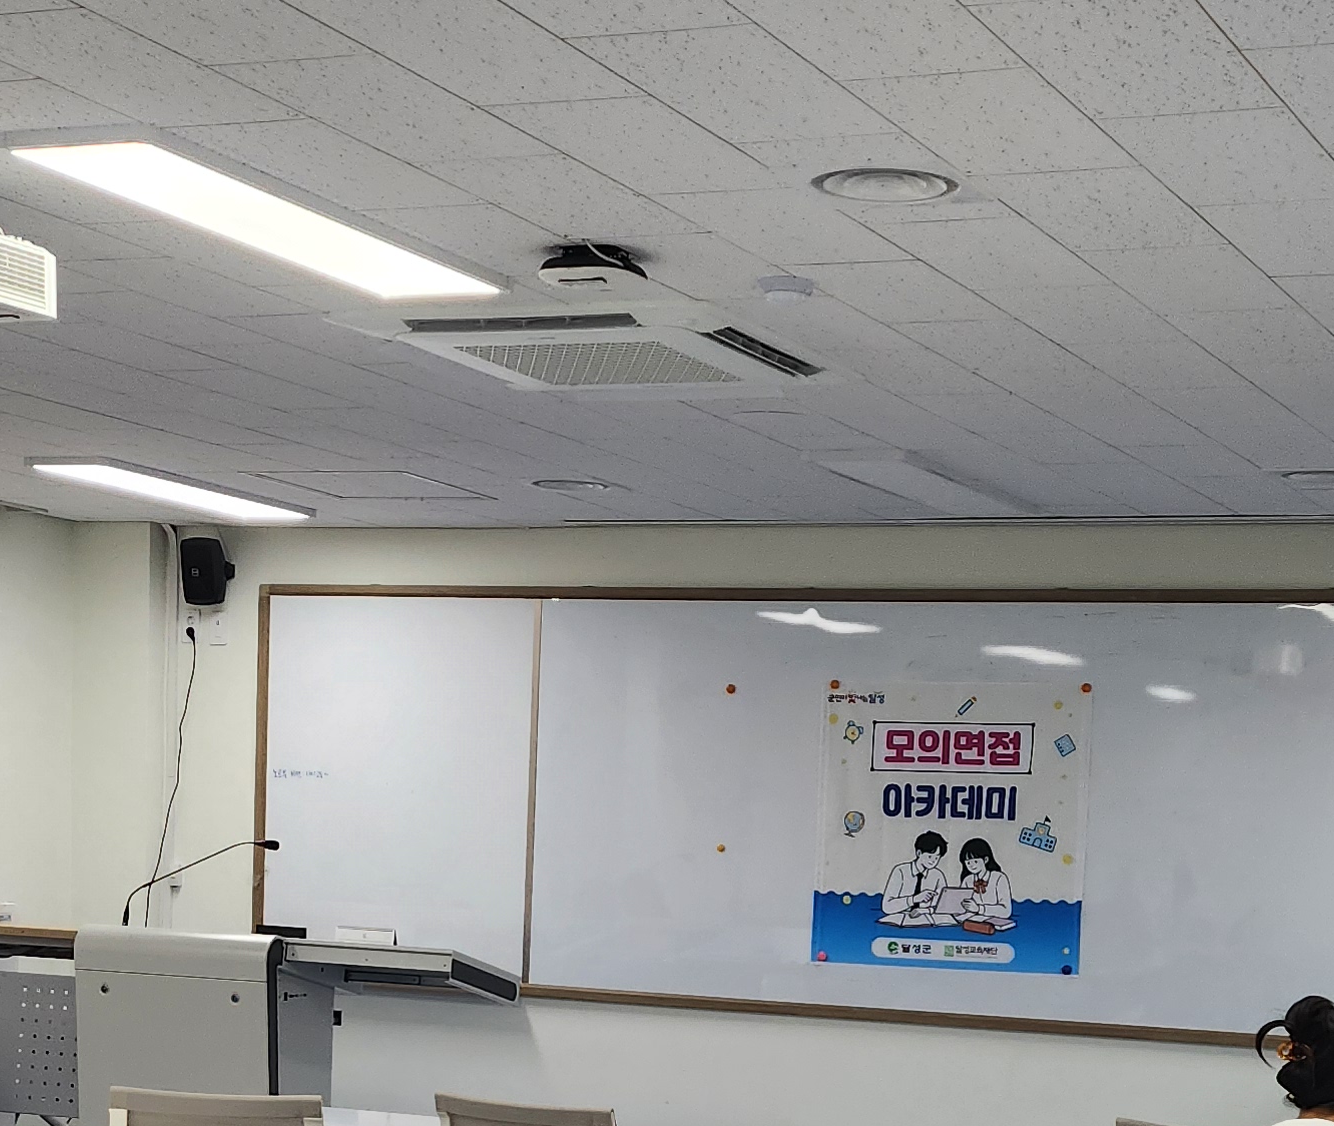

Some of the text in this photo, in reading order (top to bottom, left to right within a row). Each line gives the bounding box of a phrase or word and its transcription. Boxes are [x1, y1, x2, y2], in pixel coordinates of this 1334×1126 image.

[883, 729, 1022, 766] 모의면접
[882, 783, 1018, 821] 아카데미
[901, 943, 932, 955] 달성군
